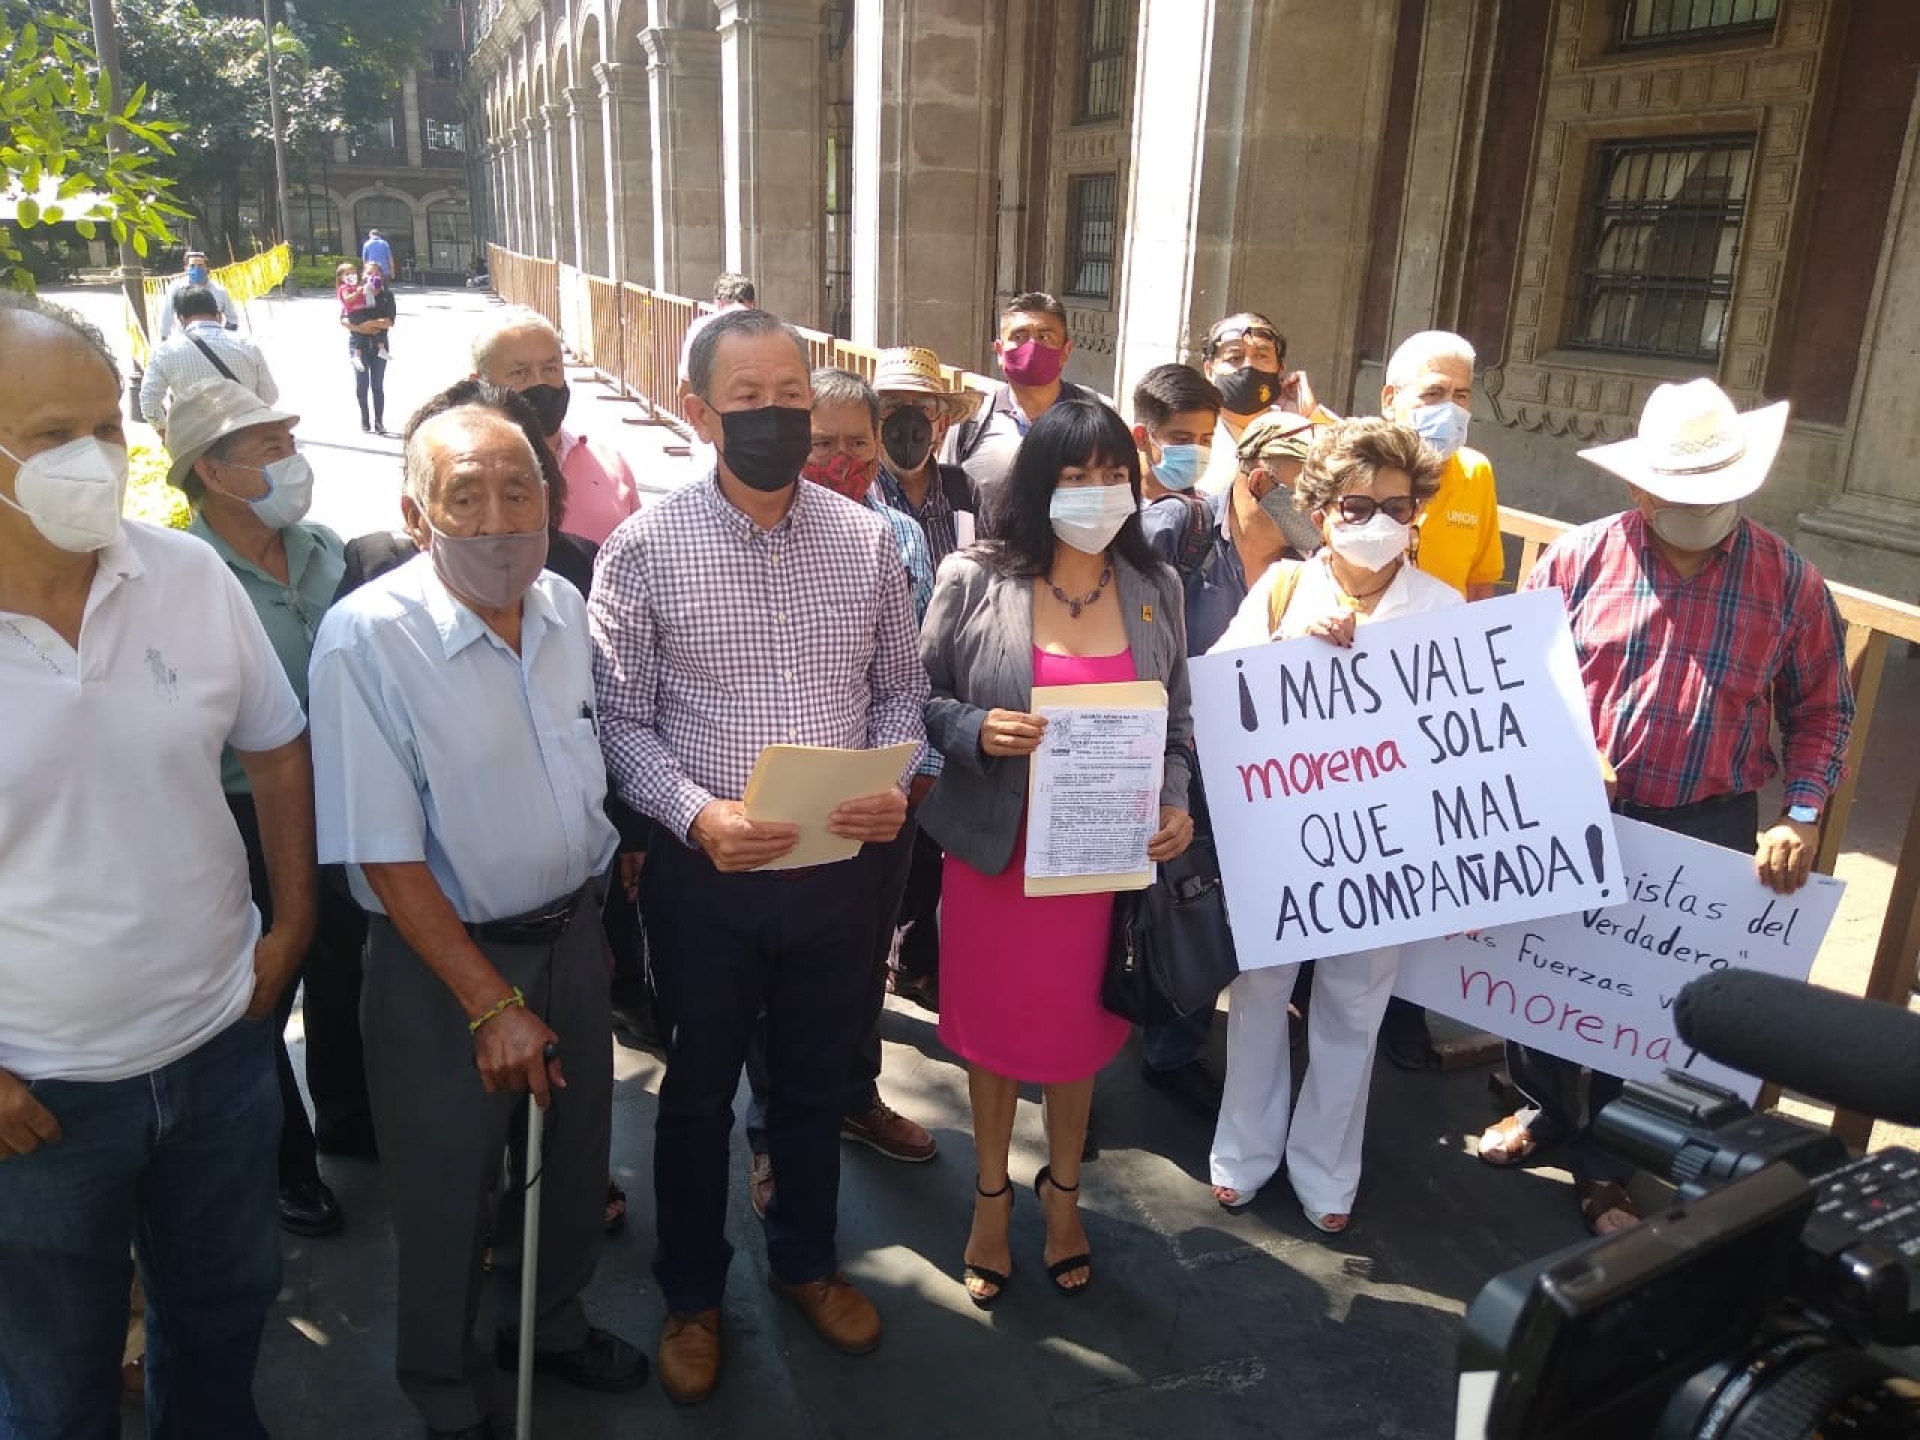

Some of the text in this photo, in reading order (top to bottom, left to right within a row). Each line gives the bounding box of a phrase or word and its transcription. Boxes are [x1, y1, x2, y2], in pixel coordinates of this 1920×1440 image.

[1390, 624, 1525, 706] VALE
[1236, 702, 1527, 802] morena SOLA
[1301, 774, 1539, 868] QUE MAL
[1517, 933, 1634, 998] Fuerzas
[1747, 900, 1799, 946] del
[1460, 965, 1672, 1064] morena
